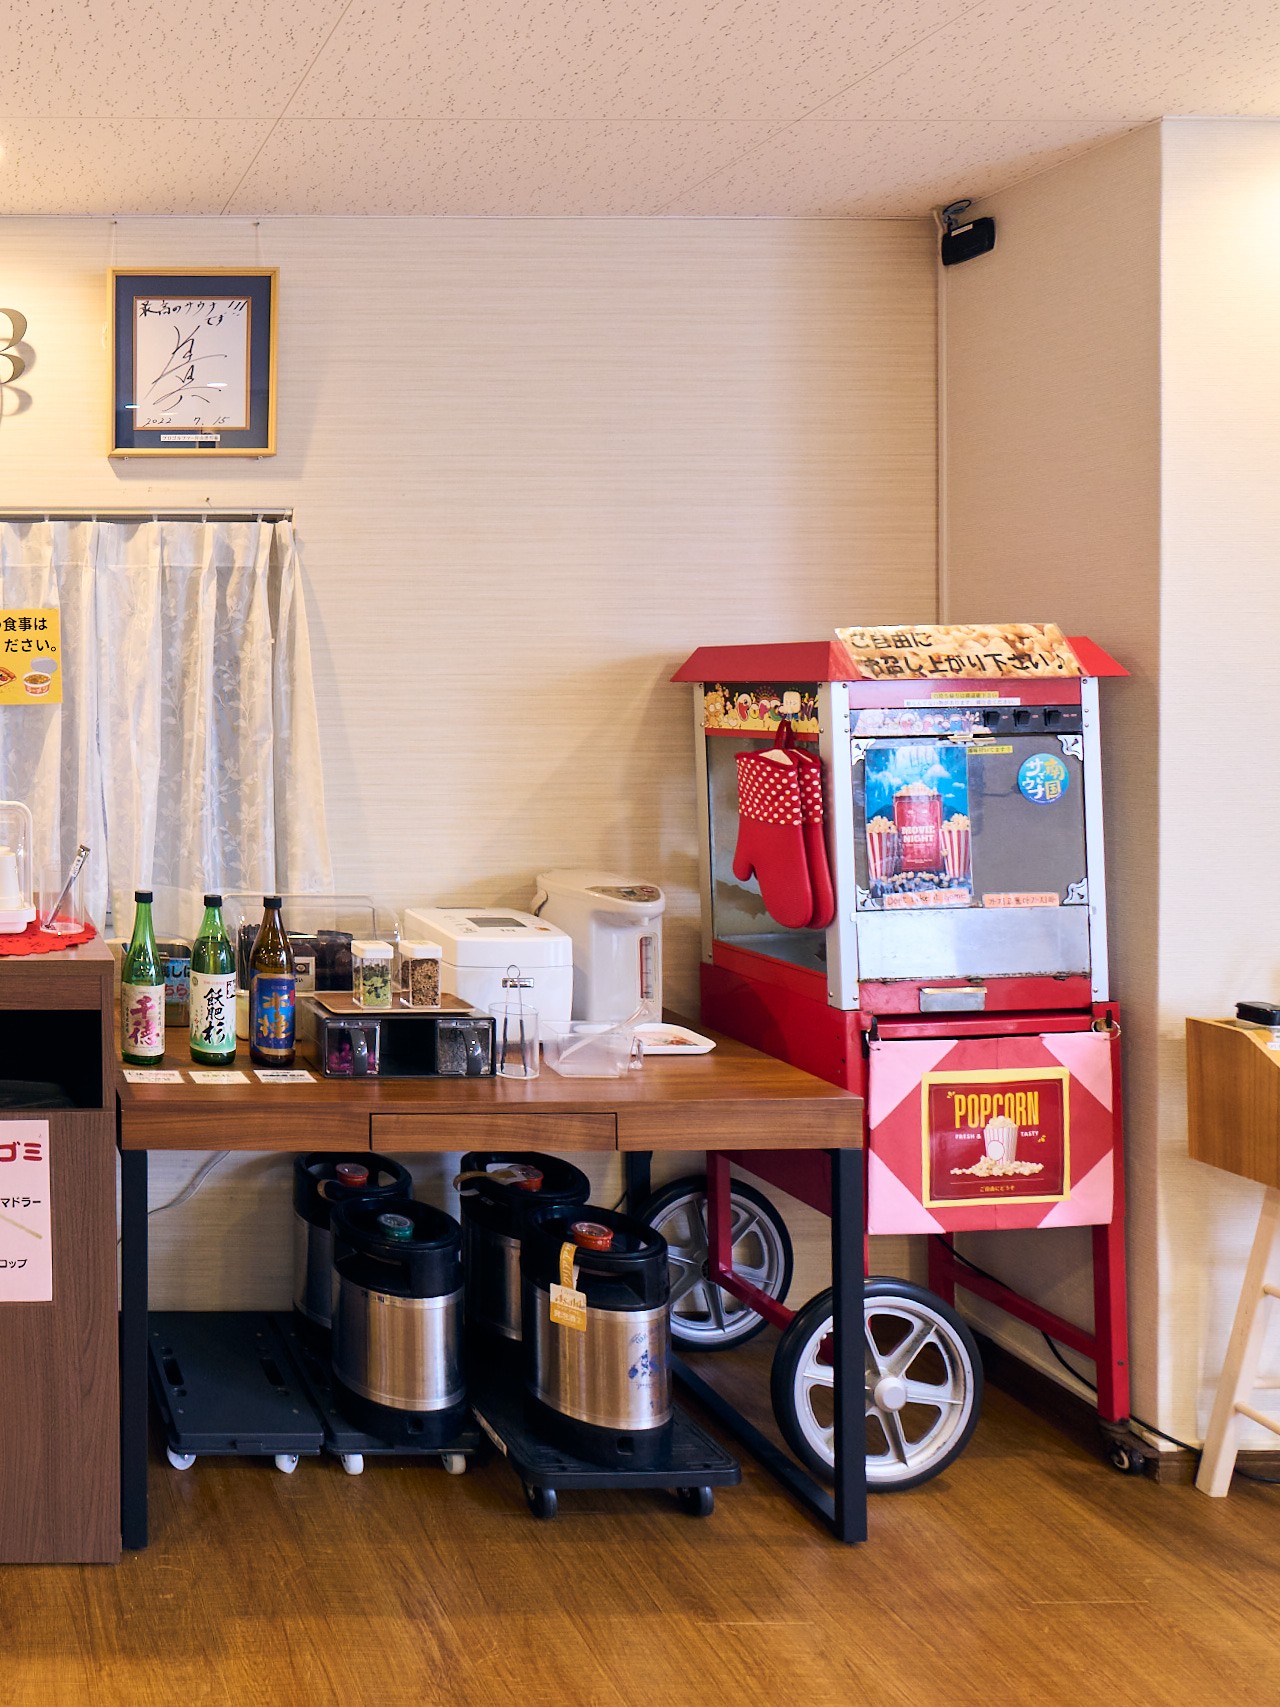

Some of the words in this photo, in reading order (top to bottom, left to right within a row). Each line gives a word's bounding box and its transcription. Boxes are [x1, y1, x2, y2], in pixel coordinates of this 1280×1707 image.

[850, 632, 933, 650] ご自由に
[1043, 757, 1065, 800] 南国
[901, 825, 935, 835] MOVIE
[903, 834, 934, 843] NIGHT
[954, 1091, 1040, 1129] POPCORN
[0, 1197, 42, 1208] マドラー
